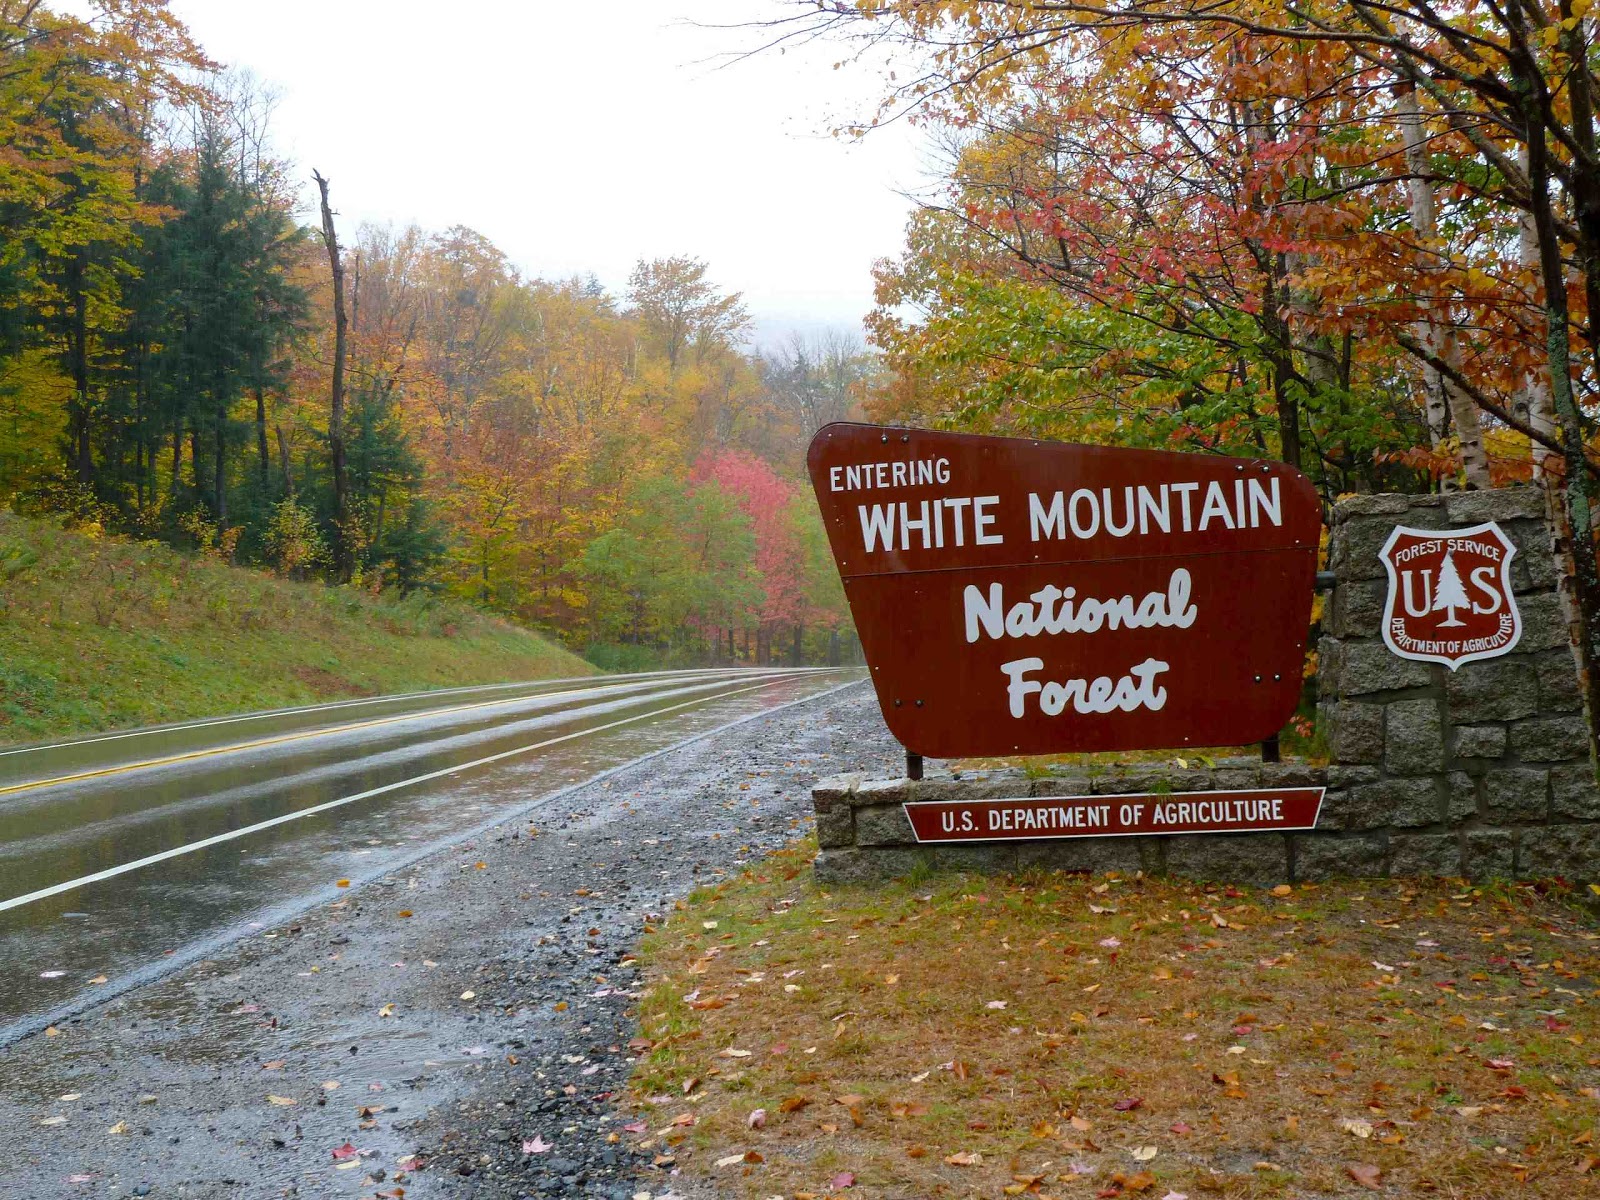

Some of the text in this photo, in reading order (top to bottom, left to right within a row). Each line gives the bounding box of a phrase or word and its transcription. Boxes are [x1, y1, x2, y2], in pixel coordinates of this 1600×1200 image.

[830, 457, 950, 492] ENTERING
[858, 476, 1282, 553] WHITE MOUNTAIN
[1395, 539, 1500, 567] FOREST SERVICE
[963, 567, 1197, 643] National
[1392, 612, 1512, 653] DEPARTMENT OF AGRICULTURE
[1000, 657, 1169, 718] Forest
[941, 799, 1284, 832] U.S. DEPARTMENT OF AGRICULTURE
